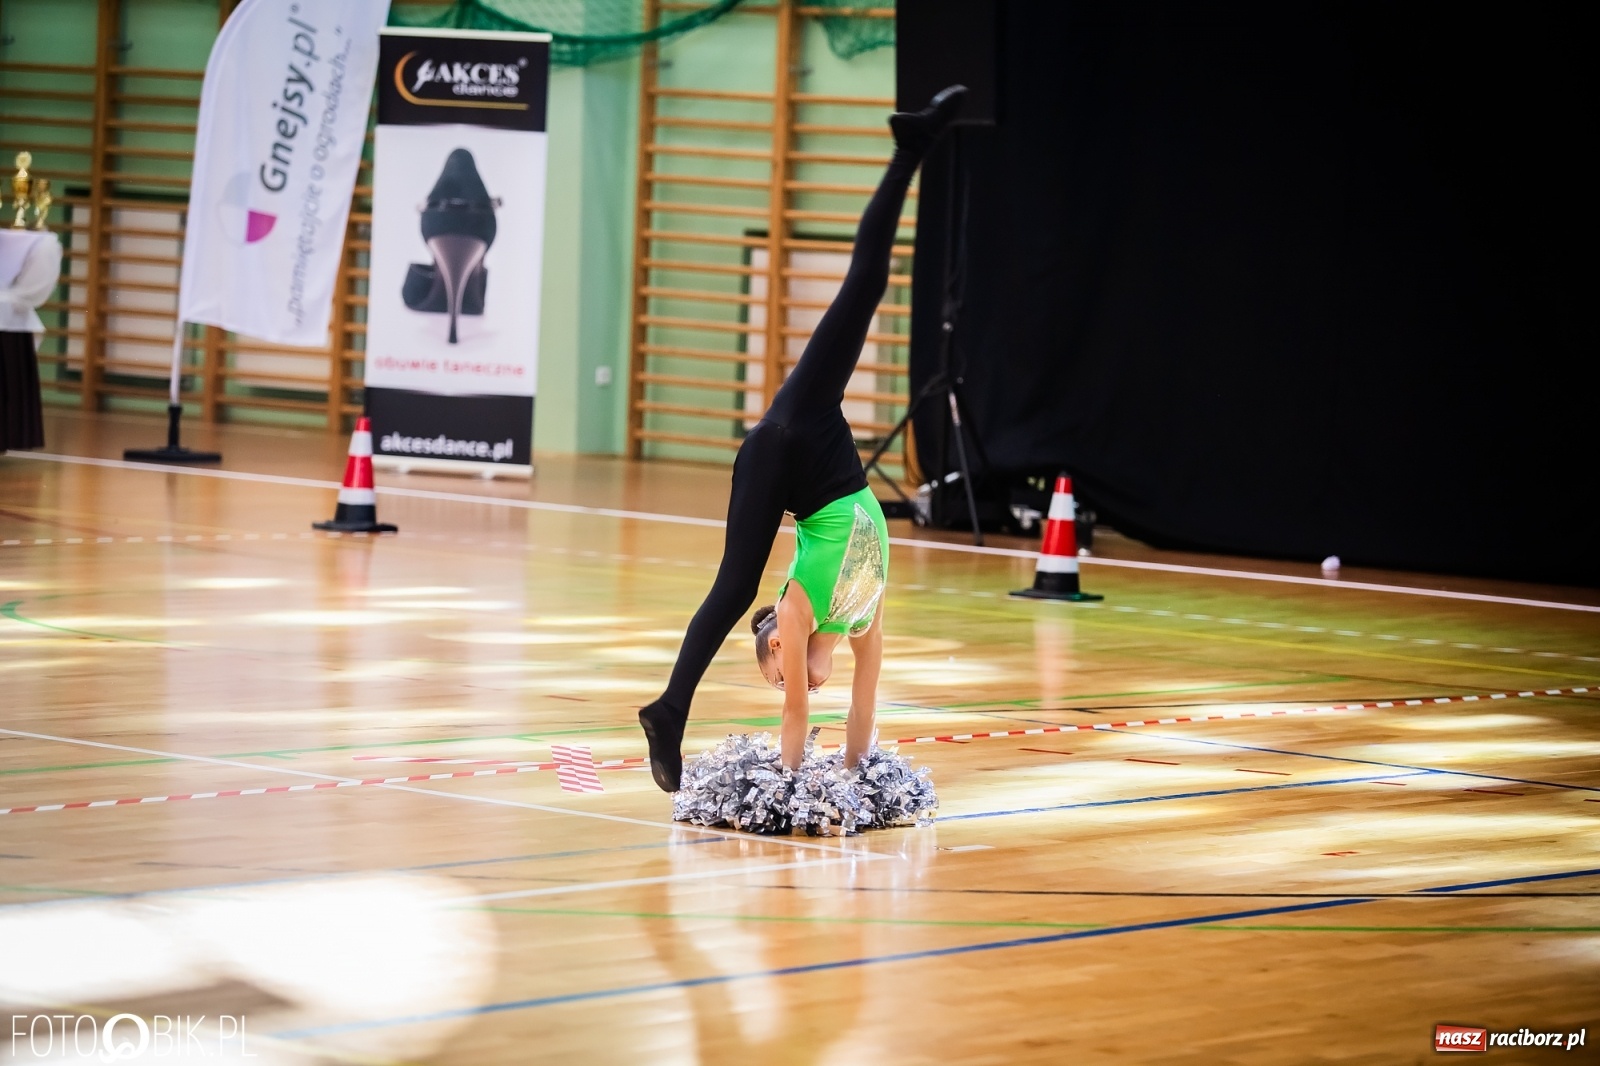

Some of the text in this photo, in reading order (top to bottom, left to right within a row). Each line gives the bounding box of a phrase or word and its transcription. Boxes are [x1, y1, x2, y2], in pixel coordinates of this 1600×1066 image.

[434, 61, 520, 85] AKCES
[310, 164, 325, 180] o
[374, 355, 526, 376] obuwie taneczne
[380, 430, 514, 462] akcesdance.pl
